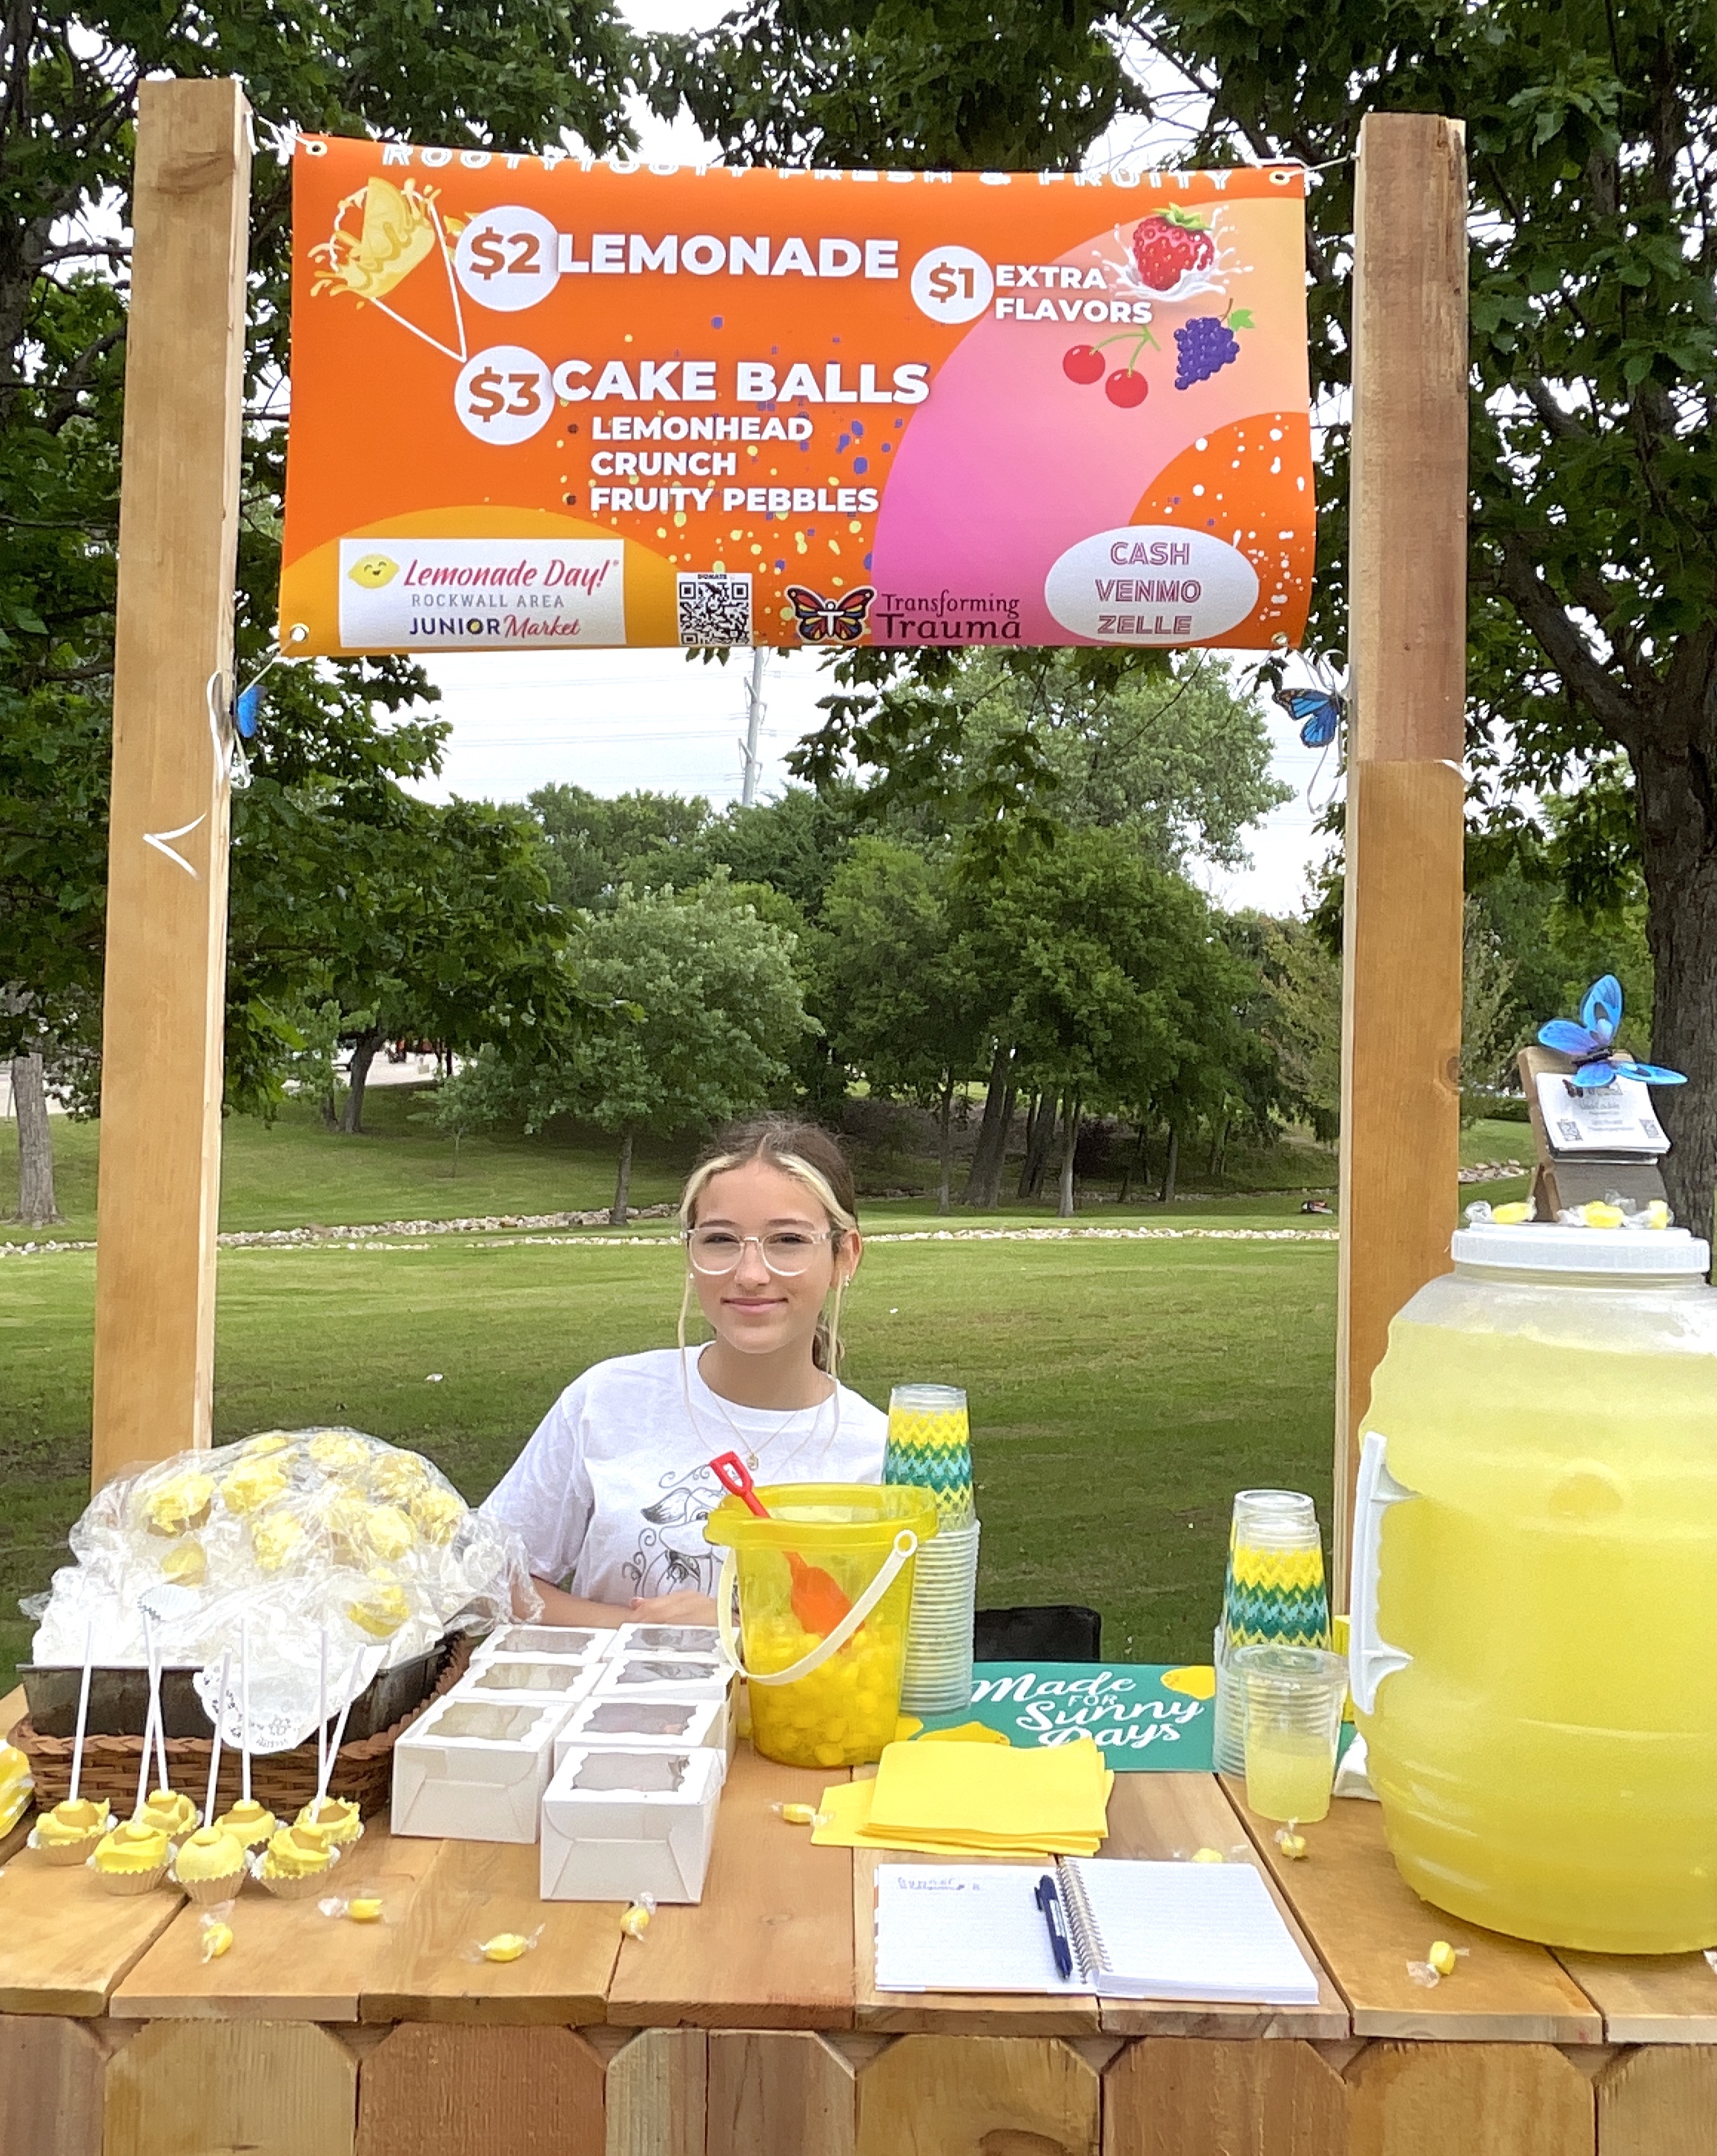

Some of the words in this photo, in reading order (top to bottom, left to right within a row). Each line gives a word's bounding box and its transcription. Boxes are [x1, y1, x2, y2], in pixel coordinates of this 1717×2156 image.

[469, 226, 541, 280] $2
[558, 234, 899, 280] LEMONADE
[928, 262, 975, 304] $1
[996, 265, 1107, 290] EXTRA
[996, 297, 1153, 325] FLAVORS
[468, 366, 541, 423] $3
[552, 360, 717, 401] CAKE
[737, 362, 930, 404] BALLS
[592, 416, 813, 441] LEMONHEAD
[591, 451, 737, 476] CRUNCH
[591, 487, 714, 512] FRUITY
[723, 488, 879, 513] PEBBLES
[1110, 541, 1190, 566] CASH
[403, 559, 537, 588] Lemonade
[411, 594, 509, 608] ROCKWALL
[516, 595, 565, 608] AREA
[881, 589, 1020, 618] Transforming
[1095, 579, 1202, 603] VENMO
[409, 618, 500, 635] JUNIOR
[504, 614, 580, 638] Market
[876, 612, 1022, 640] Trauma
[1097, 615, 1192, 635] ZELLE
[970, 1672, 1137, 1702] Made
[1068, 1695, 1117, 1707] FOR
[1016, 1701, 1205, 1731] Sunny
[1038, 1722, 1181, 1748] Days
